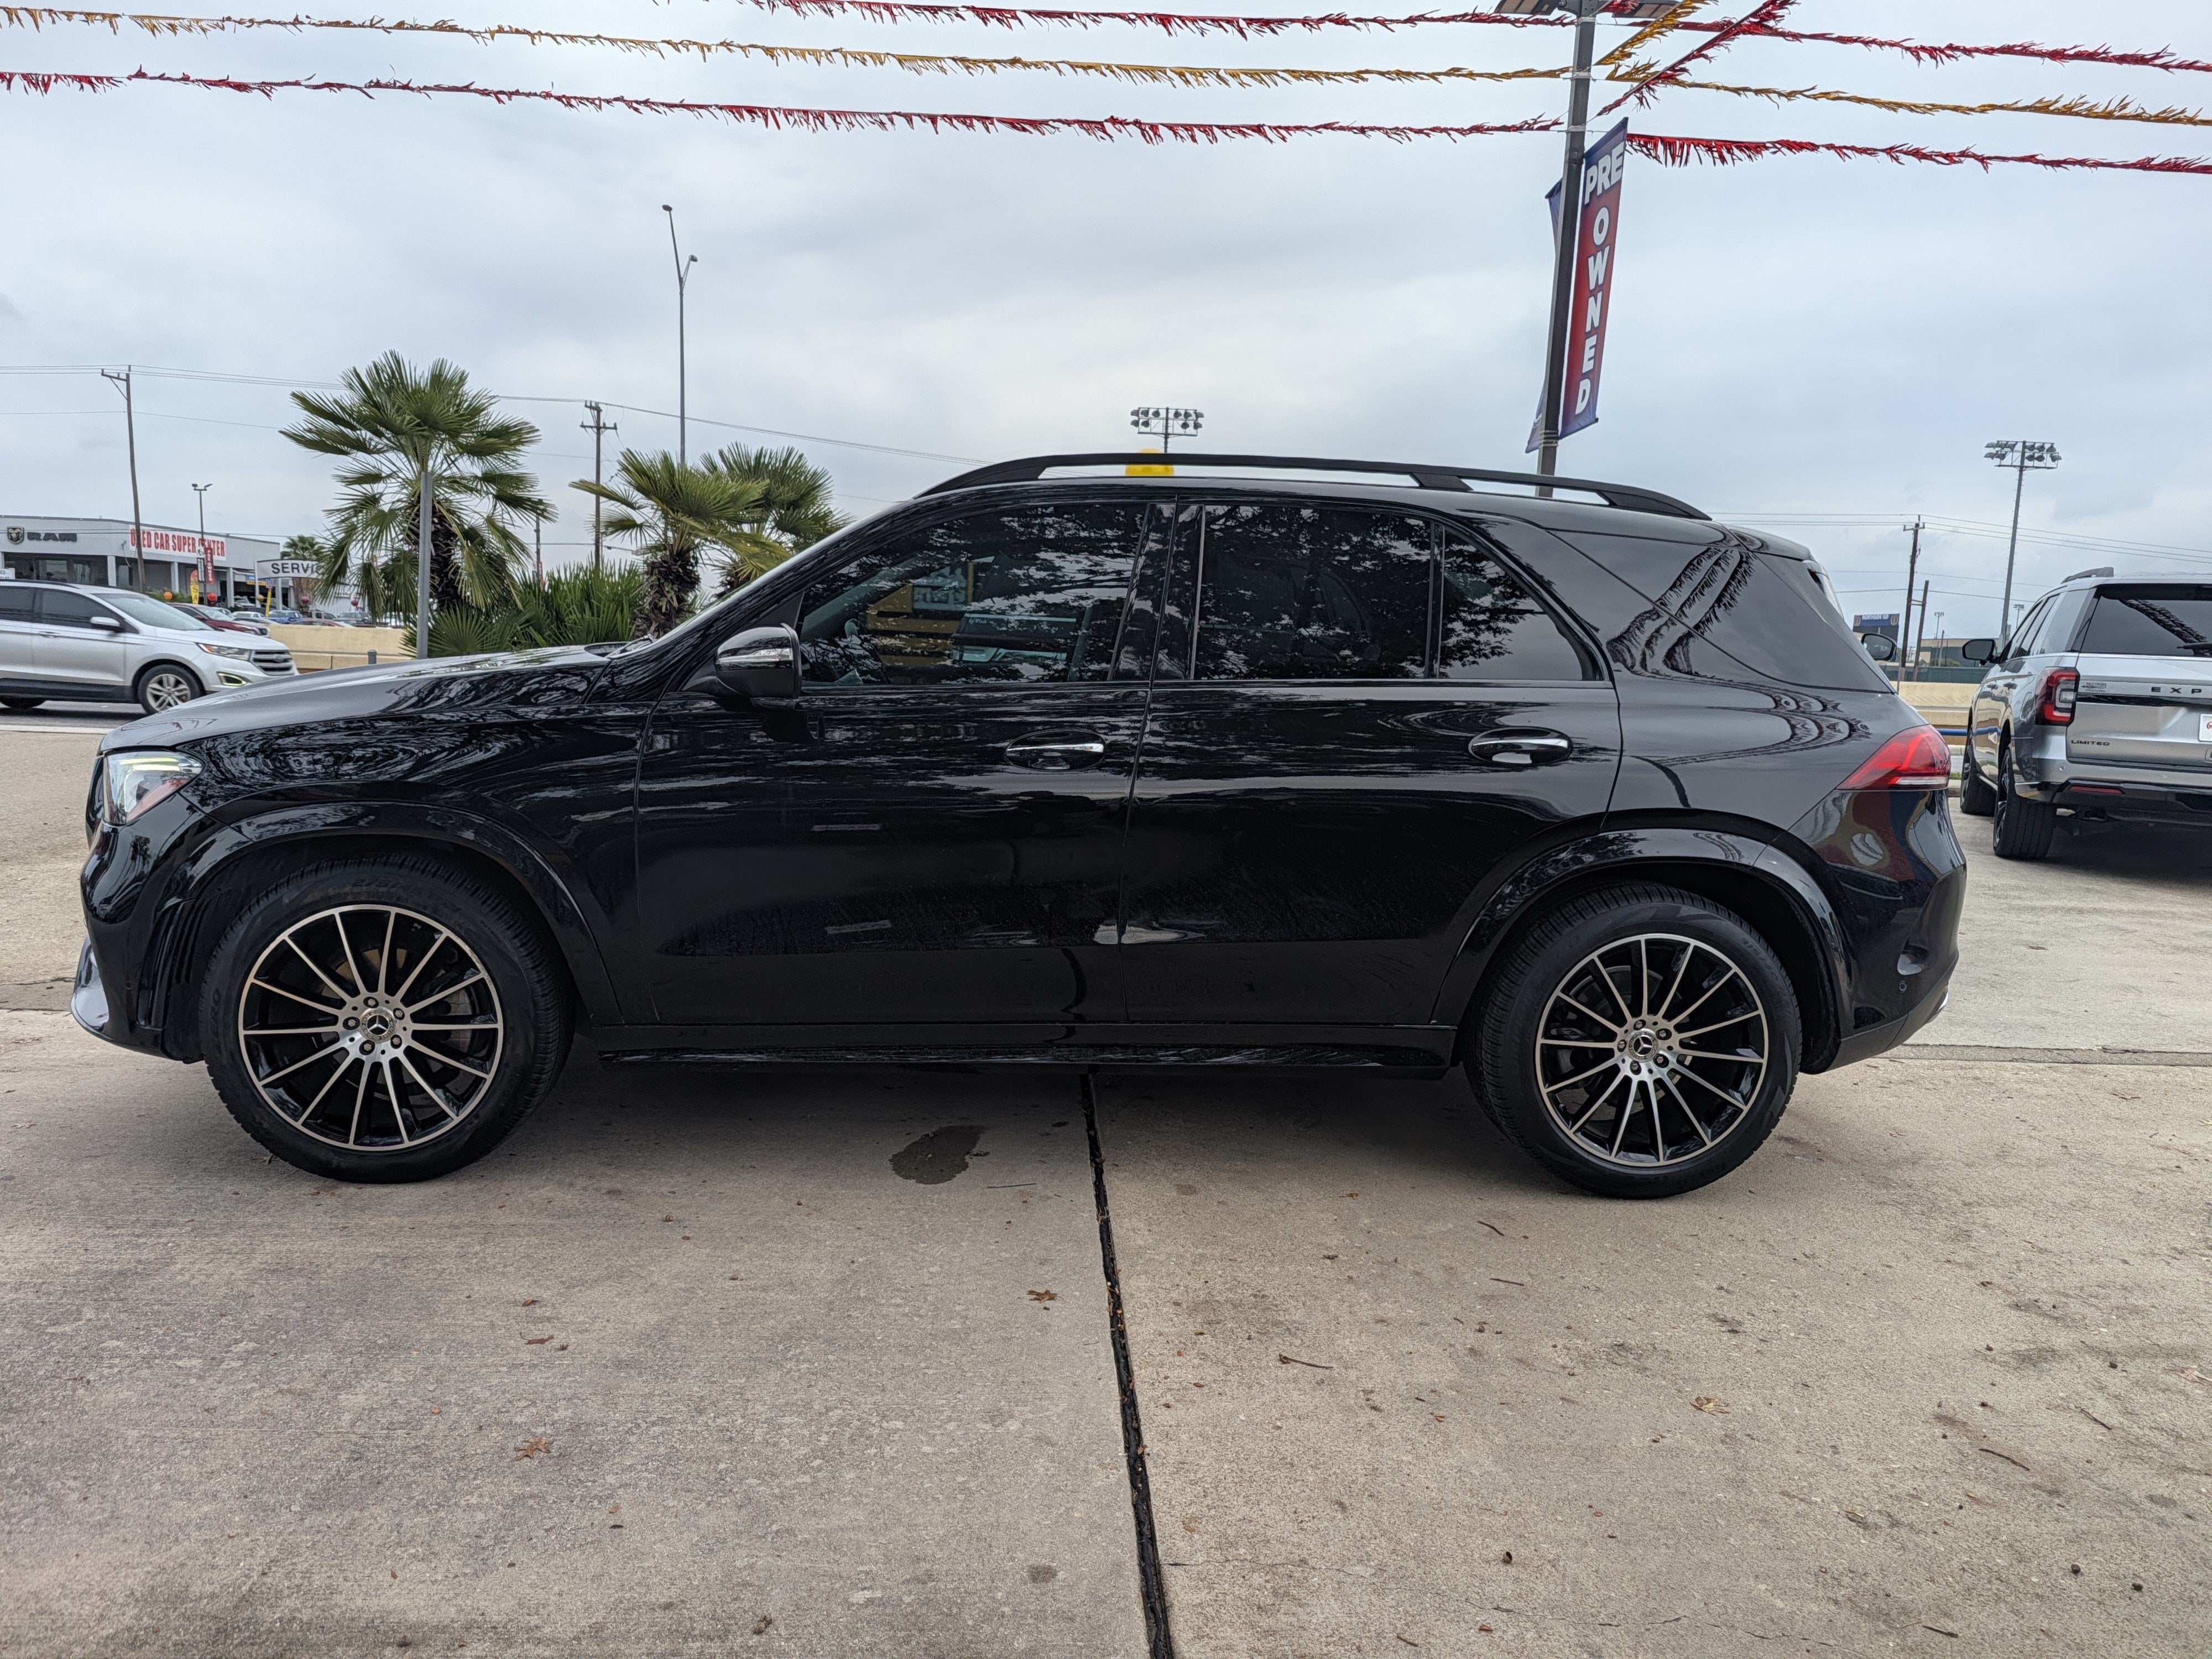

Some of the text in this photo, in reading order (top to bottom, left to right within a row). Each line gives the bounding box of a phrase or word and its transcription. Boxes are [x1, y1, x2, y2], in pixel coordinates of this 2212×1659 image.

[1575, 143, 1624, 415] PRE OWNED
[27, 532, 77, 542] RAM
[130, 528, 152, 548] UED
[154, 531, 170, 551] CAR
[171, 534, 196, 554] SUPER
[2151, 686, 2212, 695] EXP
